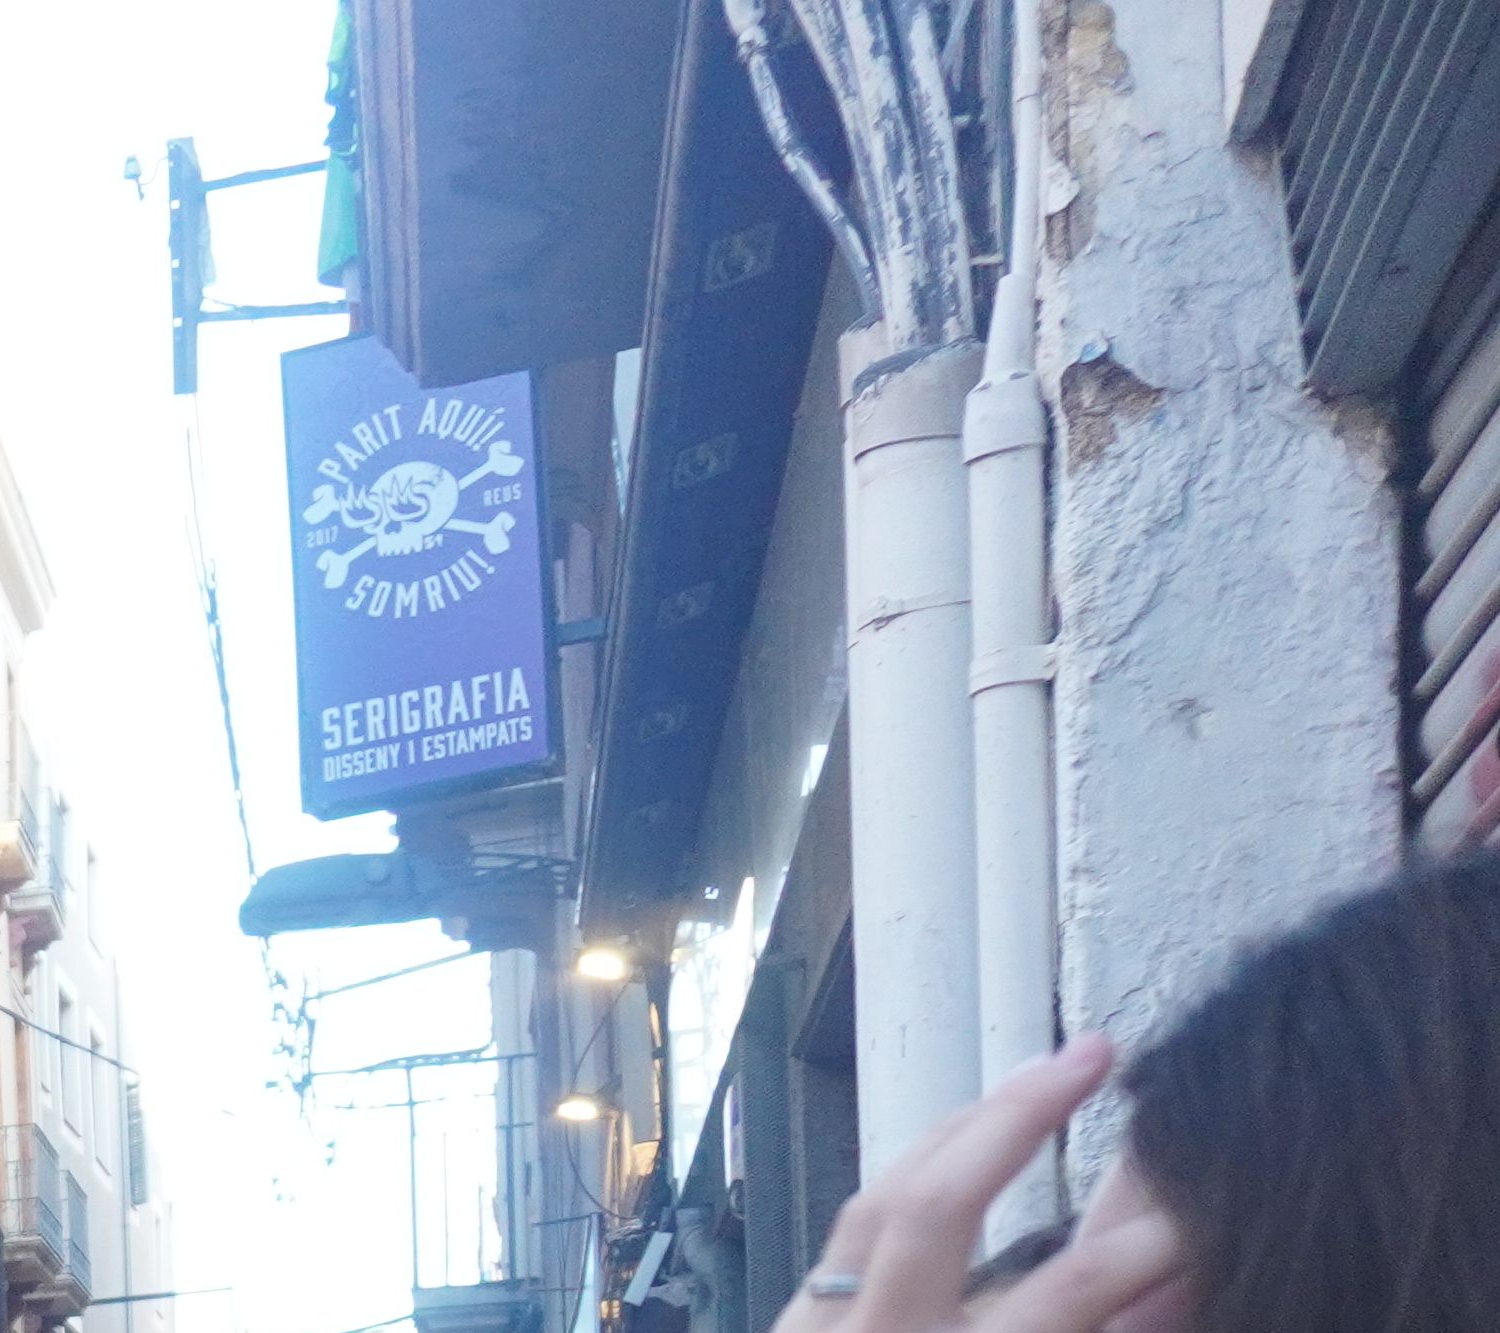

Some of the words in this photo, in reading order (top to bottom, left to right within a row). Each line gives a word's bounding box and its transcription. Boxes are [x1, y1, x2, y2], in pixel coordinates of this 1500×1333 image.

[317, 403, 401, 484] PARIT
[416, 397, 506, 452] AQUÍ!
[483, 483, 522, 507] REUS
[305, 526, 339, 549] 2017
[345, 549, 496, 619] SOMRIU!
[321, 667, 531, 750] SERIGRAFIA
[323, 741, 401, 783] DISSENY
[407, 739, 416, 765] I
[422, 715, 533, 763] ESTAMPATS
